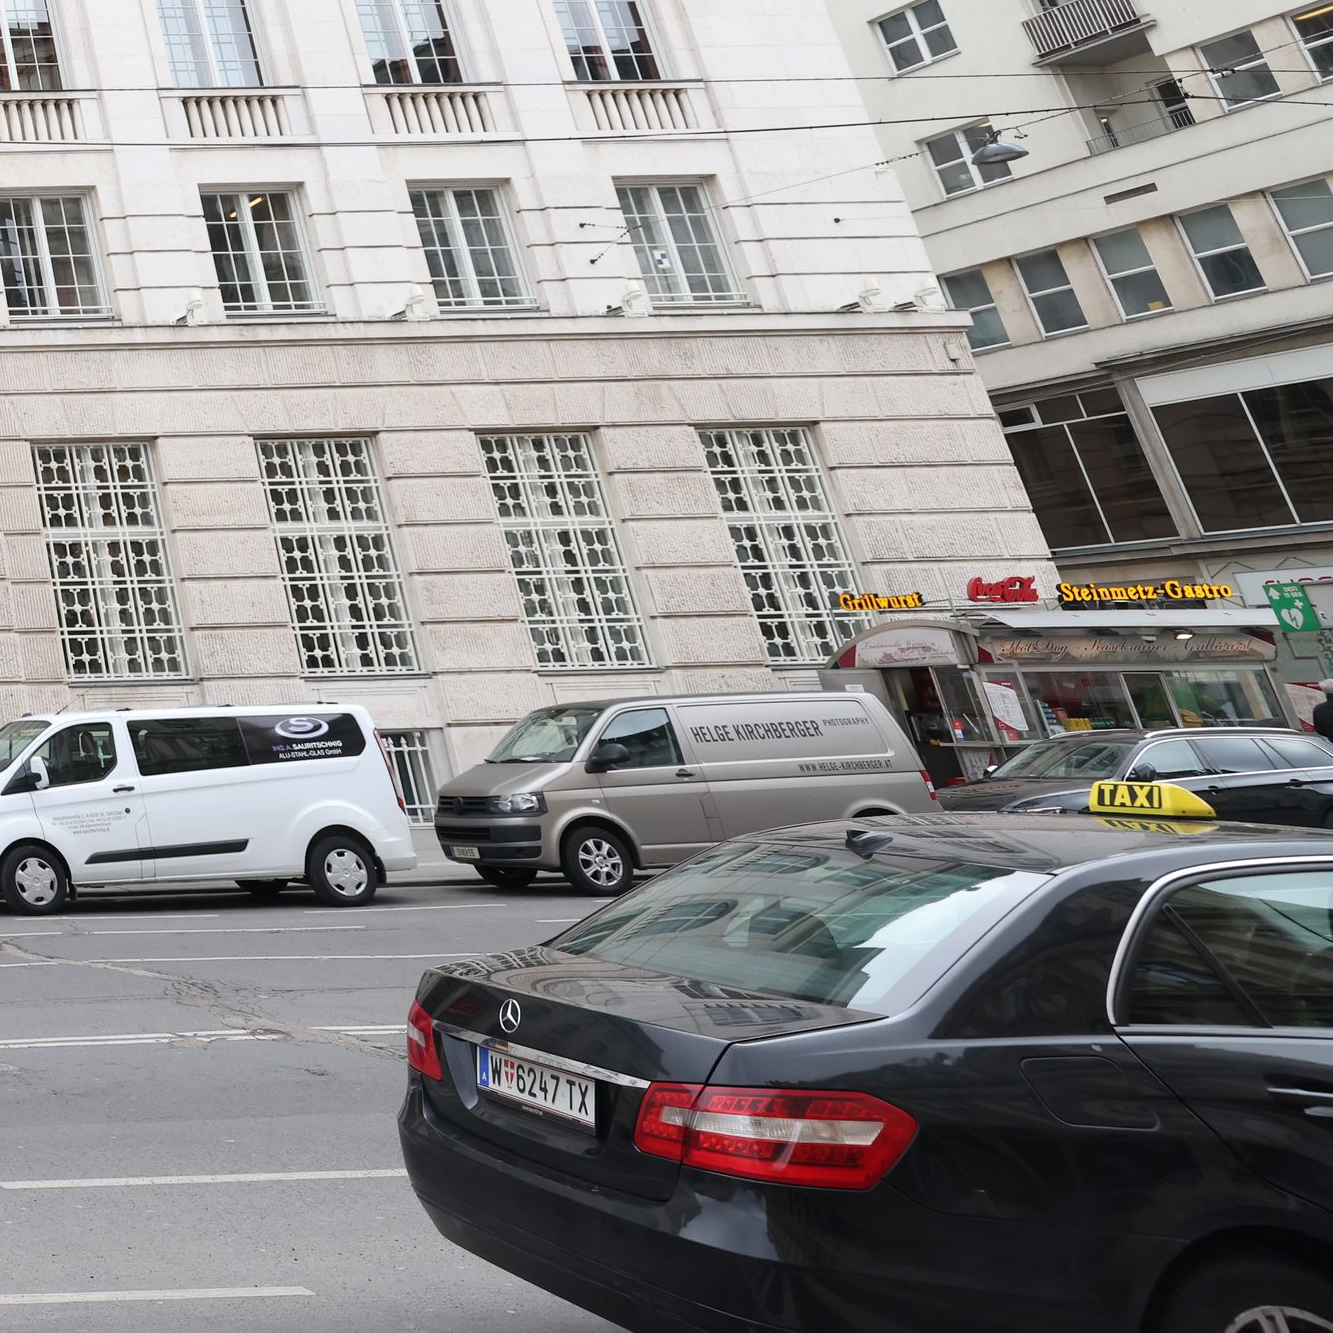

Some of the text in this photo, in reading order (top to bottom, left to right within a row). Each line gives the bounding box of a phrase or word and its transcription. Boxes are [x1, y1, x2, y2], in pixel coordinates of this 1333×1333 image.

[1060, 580, 1232, 602] Steinmetz-Gastro
[839, 592, 923, 611] Grillwurst
[1001, 639, 1032, 652] Hot
[1033, 639, 1068, 662] Dog
[690, 717, 870, 743] HELGE KIRCHBERGER PHOTOGRAPHY
[279, 750, 325, 758] ALU-STAHL-GLAS
[292, 740, 342, 750] SAURITSCHNIG
[797, 759, 893, 772] WWW.HELGE-KIRCHBERGER.AT
[1100, 784, 1161, 808] TAXI
[481, 1072, 487, 1081] A
[490, 1055, 589, 1116] W 6247 TX
